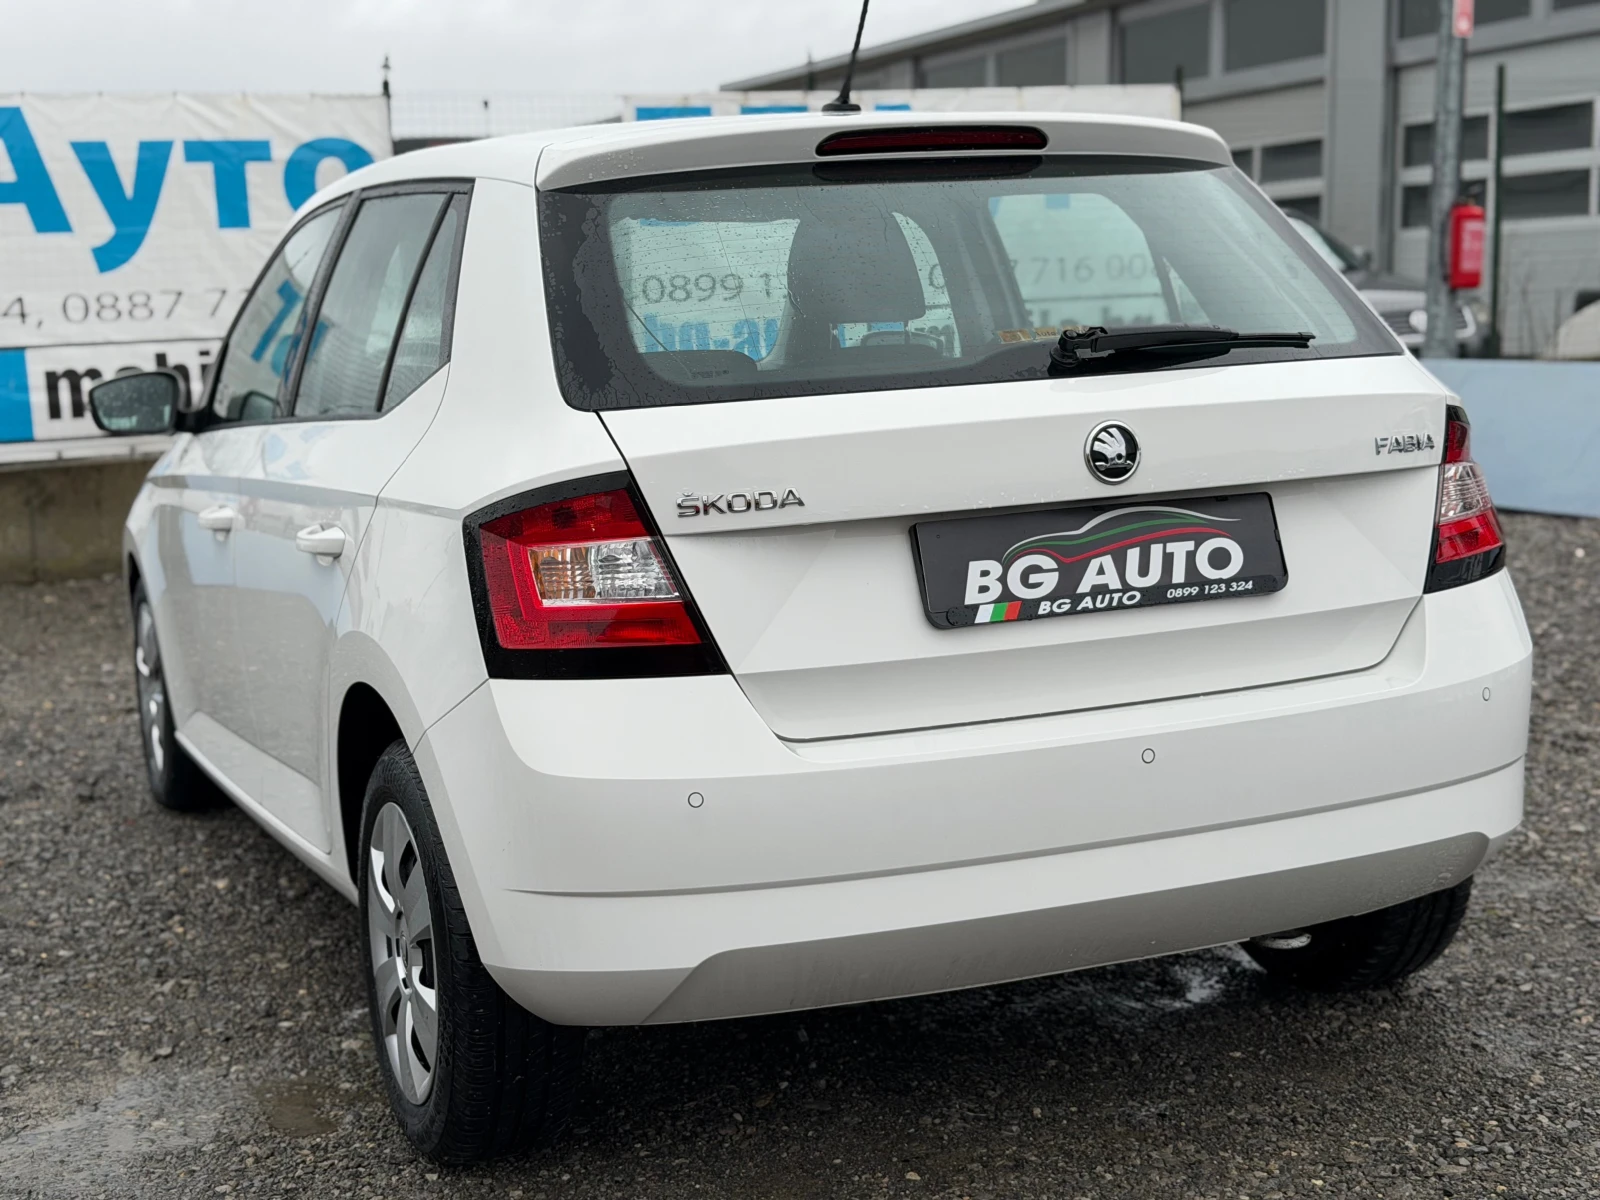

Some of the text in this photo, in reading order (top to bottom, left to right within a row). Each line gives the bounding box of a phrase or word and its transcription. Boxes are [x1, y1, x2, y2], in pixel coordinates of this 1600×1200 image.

[642, 273, 745, 303] 0899
[759, 272, 788, 299] 1
[1030, 255, 1095, 285] 716
[1105, 253, 1157, 280] 00
[62, 289, 184, 323] 0887
[205, 288, 250, 318] 7
[1374, 432, 1435, 456] FABIA
[676, 487, 805, 518] ŠKODA
[964, 537, 1244, 605] BG AUTO
[1037, 580, 1253, 615] BG AUTO 0899 123 324
